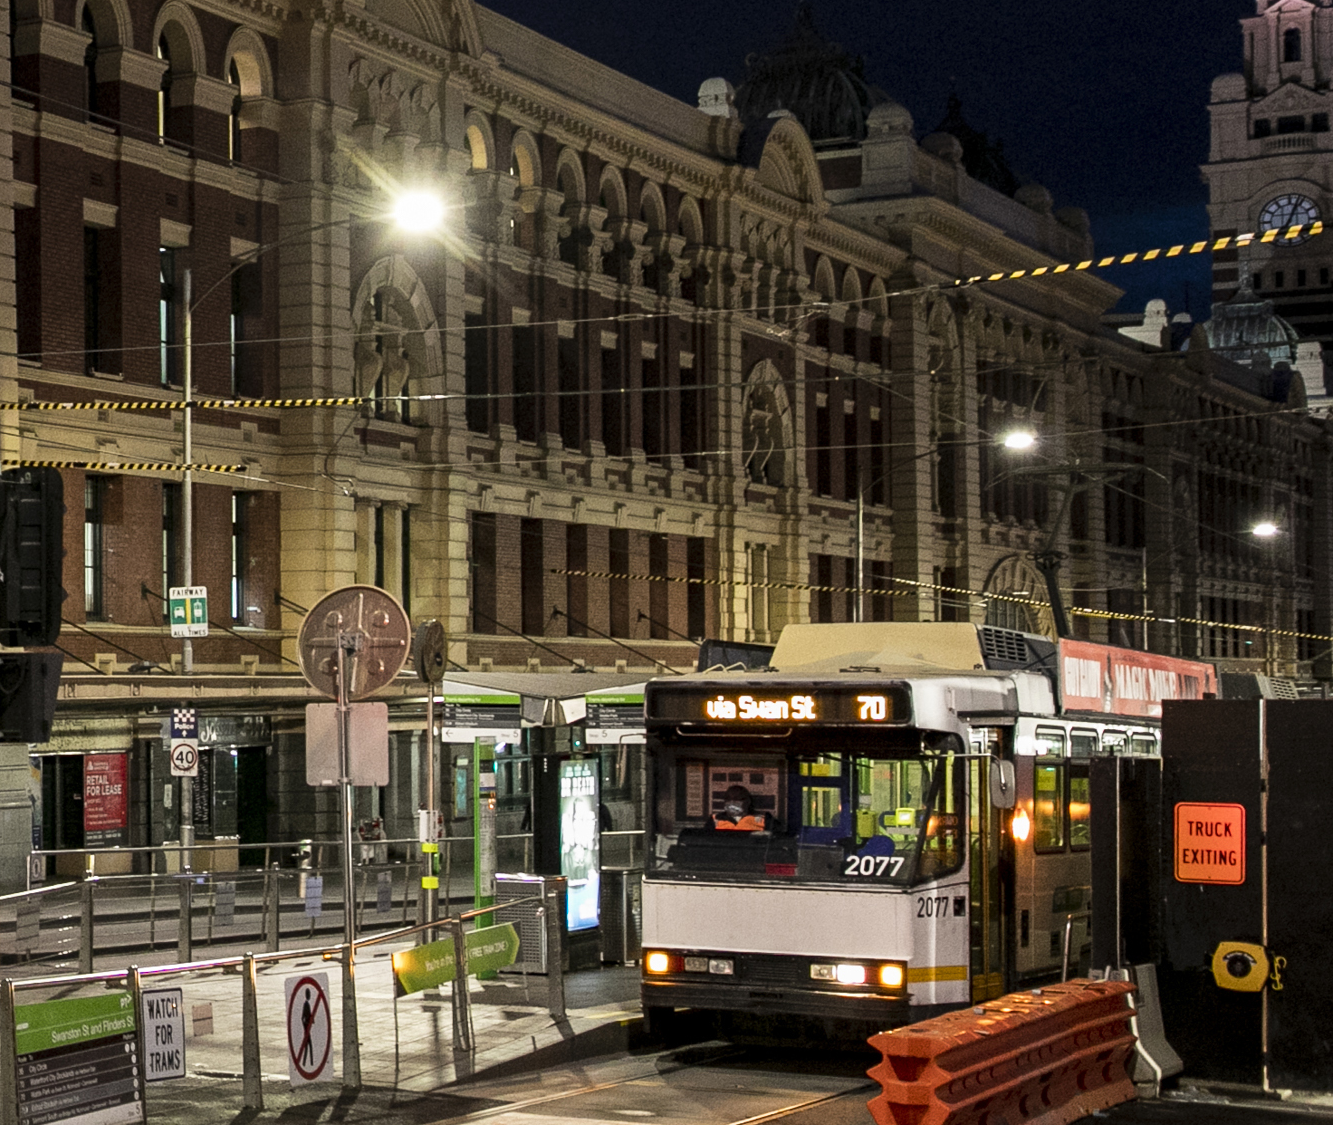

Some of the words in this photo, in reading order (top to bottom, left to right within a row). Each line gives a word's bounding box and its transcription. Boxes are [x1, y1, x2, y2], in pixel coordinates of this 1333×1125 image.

[172, 588, 204, 597] FAIRWAY
[706, 695, 736, 719] via
[738, 695, 789, 719] Swan
[791, 695, 816, 719] St
[857, 695, 886, 720] 70
[512, 730, 519, 738] 5
[602, 730, 608, 738] 5
[175, 750, 194, 764] 40
[86, 775, 109, 785] RETAIL
[86, 785, 101, 796] FOR
[101, 784, 122, 796] LEASE
[1187, 820, 1233, 838] TRUCK
[844, 855, 905, 877] 2077
[1182, 848, 1237, 866] EXITING
[916, 896, 949, 918] 2077
[147, 997, 179, 1020] WATCH
[51, 1027, 81, 1044] Swanston
[82, 1024, 90, 1037] St
[90, 1022, 102, 1035] and
[102, 1018, 126, 1033] Flinders
[155, 1024, 173, 1046] FOR
[149, 1049, 181, 1073] TRAMS
[135, 1104, 141, 1115] 5
